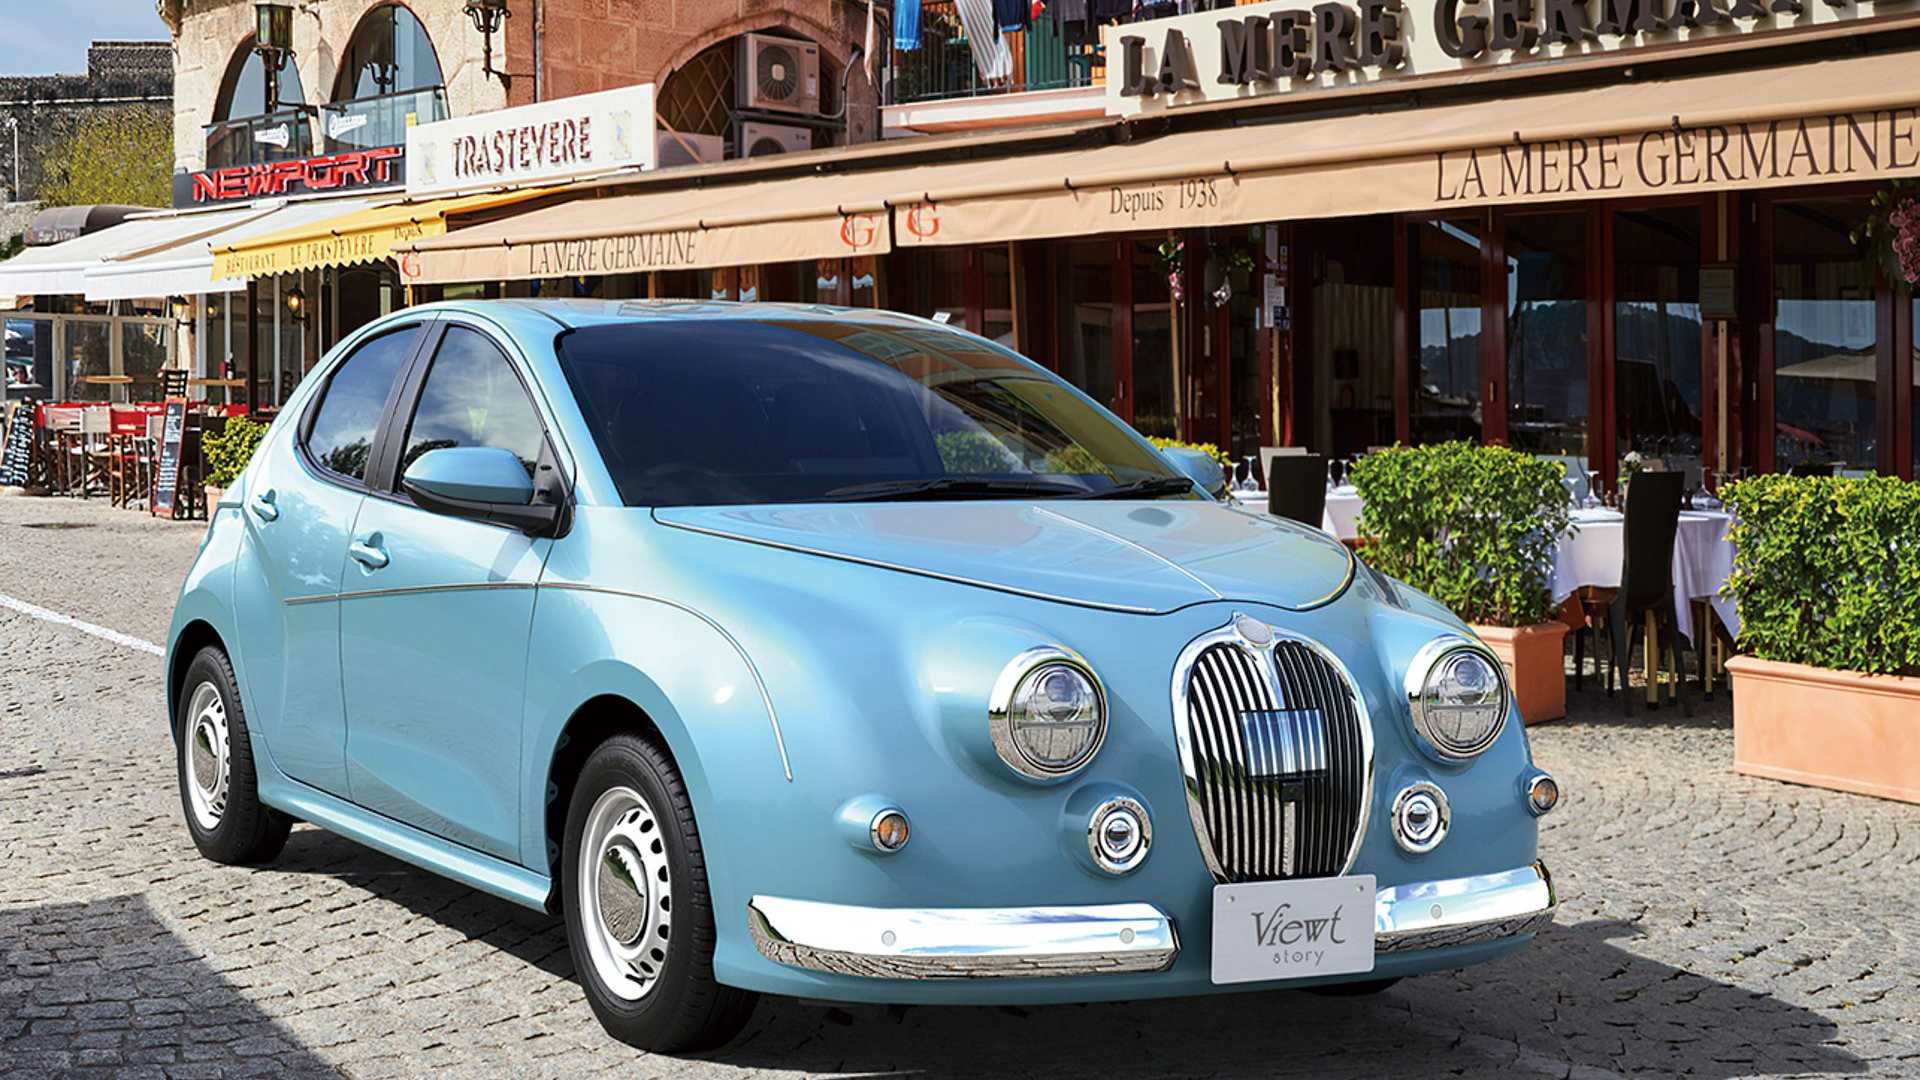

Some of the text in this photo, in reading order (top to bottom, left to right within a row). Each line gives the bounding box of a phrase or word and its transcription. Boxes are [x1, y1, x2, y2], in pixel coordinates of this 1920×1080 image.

[1120, 28, 1190, 97] LA
[1216, 0, 1406, 85] MERE
[452, 116, 592, 178] TRASTEVERE
[1435, 108, 1920, 201] LA MERE GERMAINE
[192, 147, 403, 202] NEWPORT
[1110, 178, 1218, 221] Depuis 1938
[529, 231, 696, 274] LA MERE GERMAINE
[1251, 903, 1345, 947] Viewt
[1273, 949, 1325, 967] story
